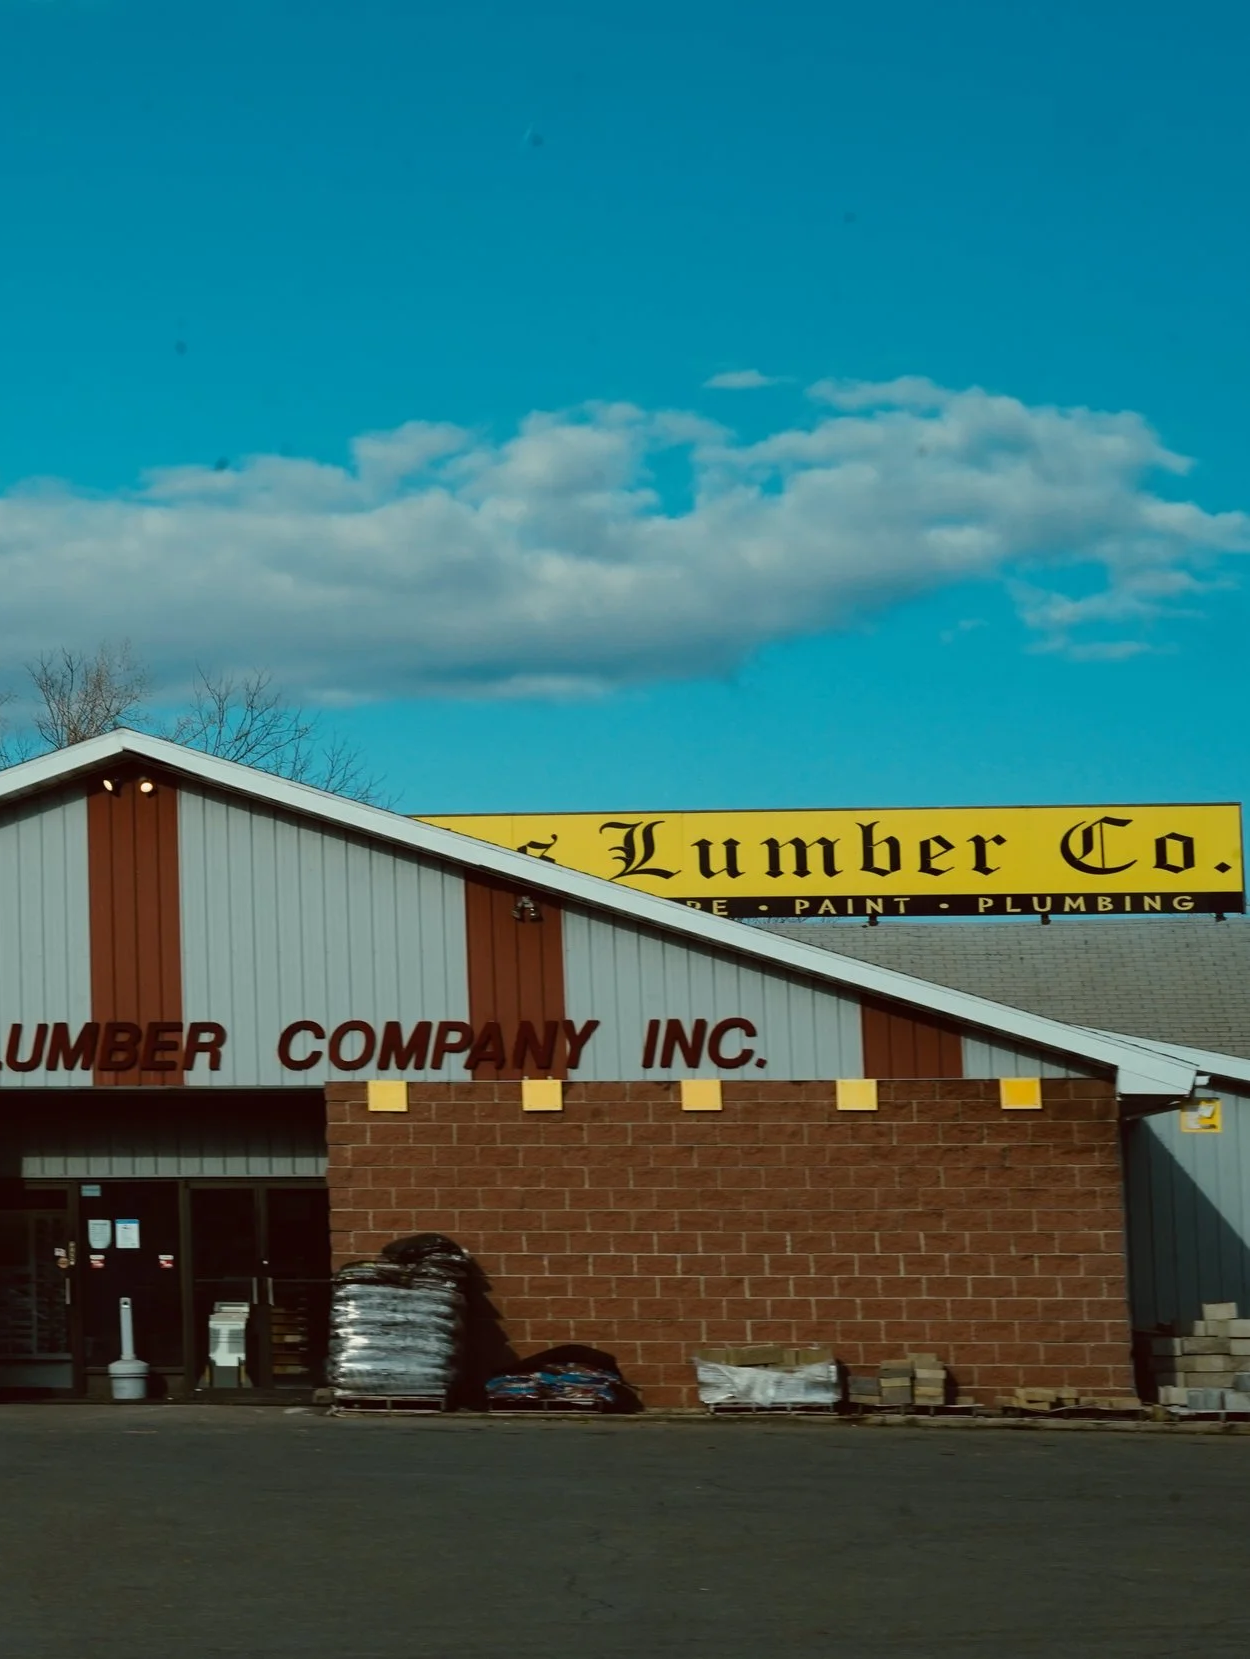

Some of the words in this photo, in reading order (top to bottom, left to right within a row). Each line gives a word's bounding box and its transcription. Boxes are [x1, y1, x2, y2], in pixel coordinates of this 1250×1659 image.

[599, 819, 1007, 881] Lumber
[1060, 816, 1232, 875] Co.
[795, 897, 911, 915] PAINT
[978, 895, 1195, 913] PLUMBING
[277, 1018, 600, 1071] COMPANY
[641, 1016, 768, 1070] INC.
